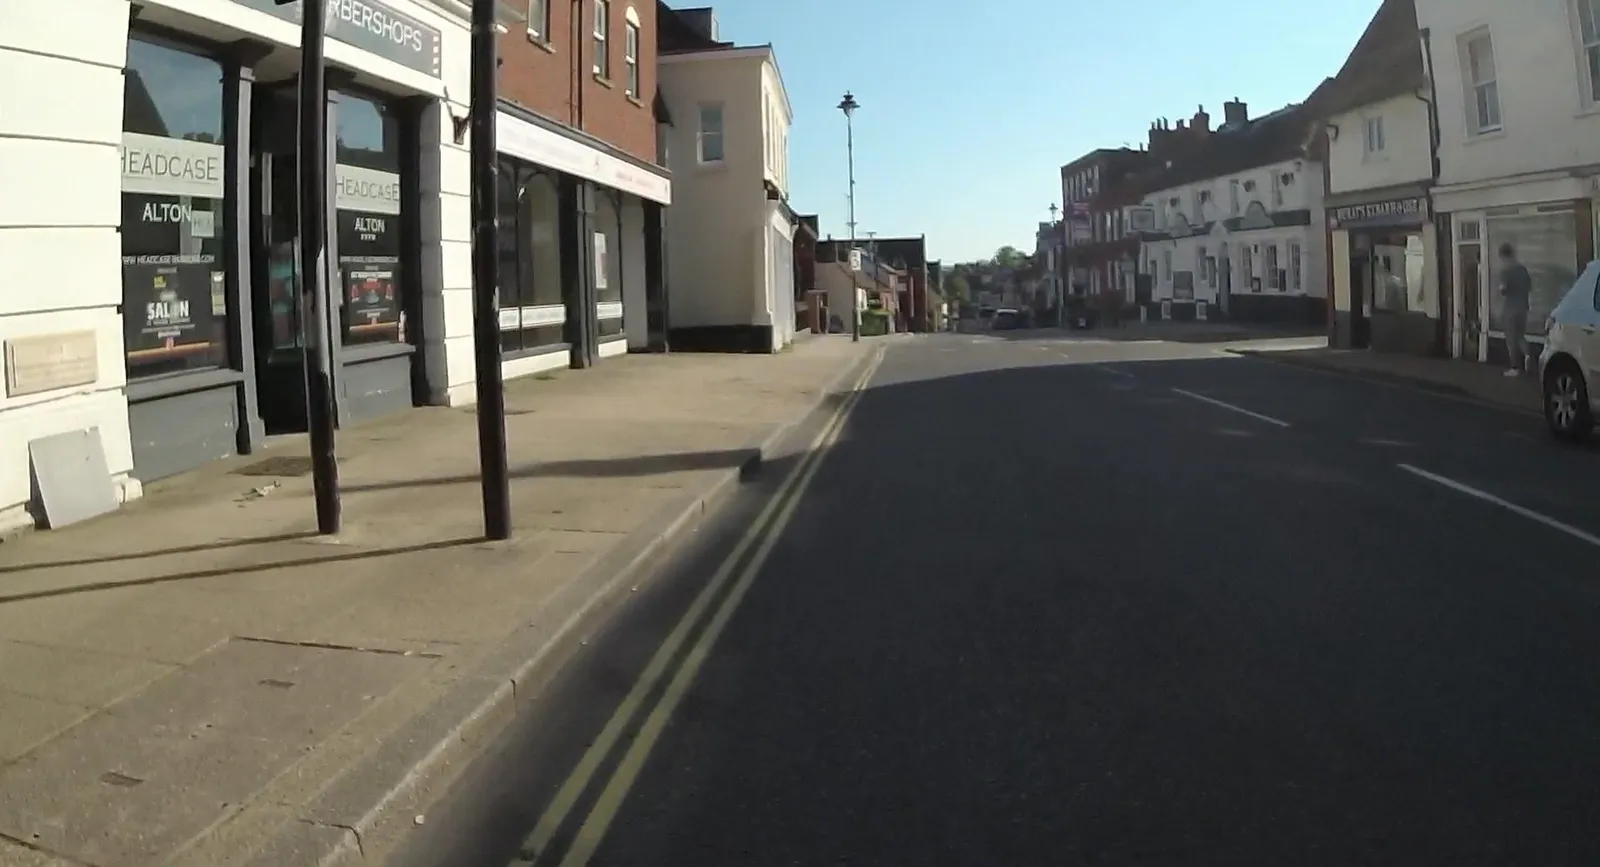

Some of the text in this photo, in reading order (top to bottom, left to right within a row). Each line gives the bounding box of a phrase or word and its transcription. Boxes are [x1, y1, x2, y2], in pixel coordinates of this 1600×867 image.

[328, 0, 422, 52] RBERSHOPS
[142, 203, 192, 222] ALTON
[354, 217, 385, 233] ALTON
[147, 300, 190, 320] SALN
